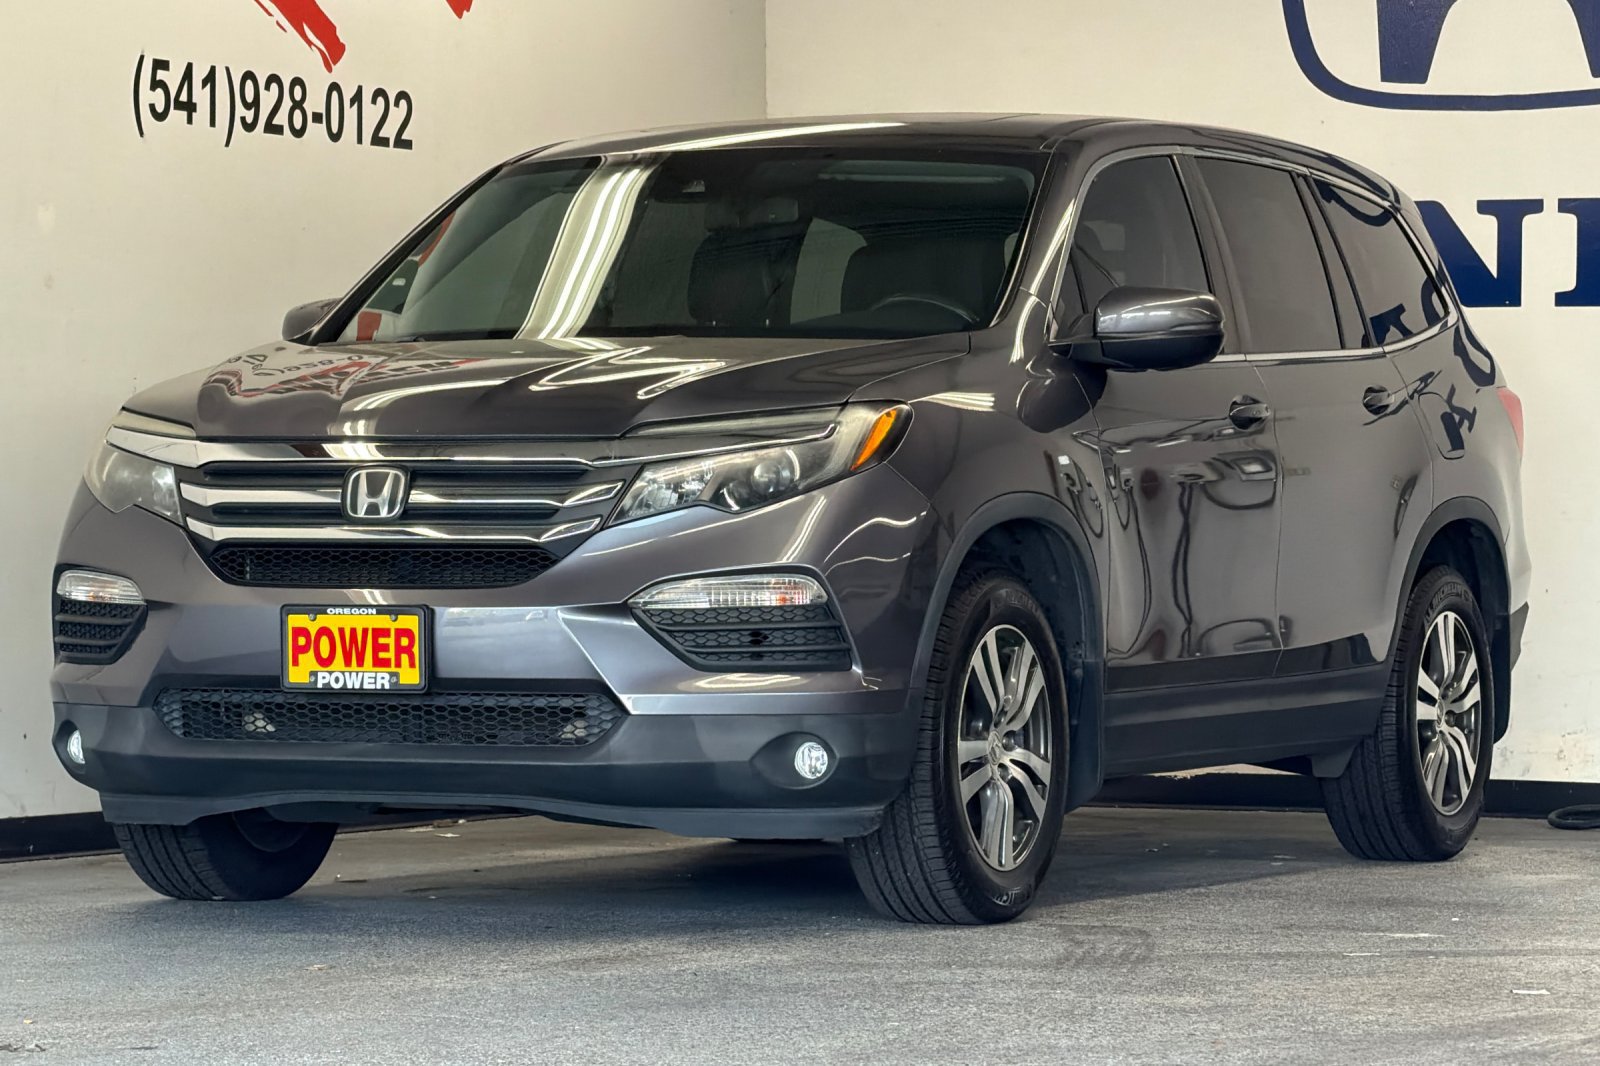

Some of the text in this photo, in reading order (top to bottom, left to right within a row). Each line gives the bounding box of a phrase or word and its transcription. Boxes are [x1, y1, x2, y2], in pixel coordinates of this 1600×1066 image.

[133, 53, 413, 150] (541)928-0122
[1414, 198, 1600, 307] N
[326, 607, 376, 615] OREGON
[291, 626, 416, 668] POWER
[317, 672, 390, 689] POWER
